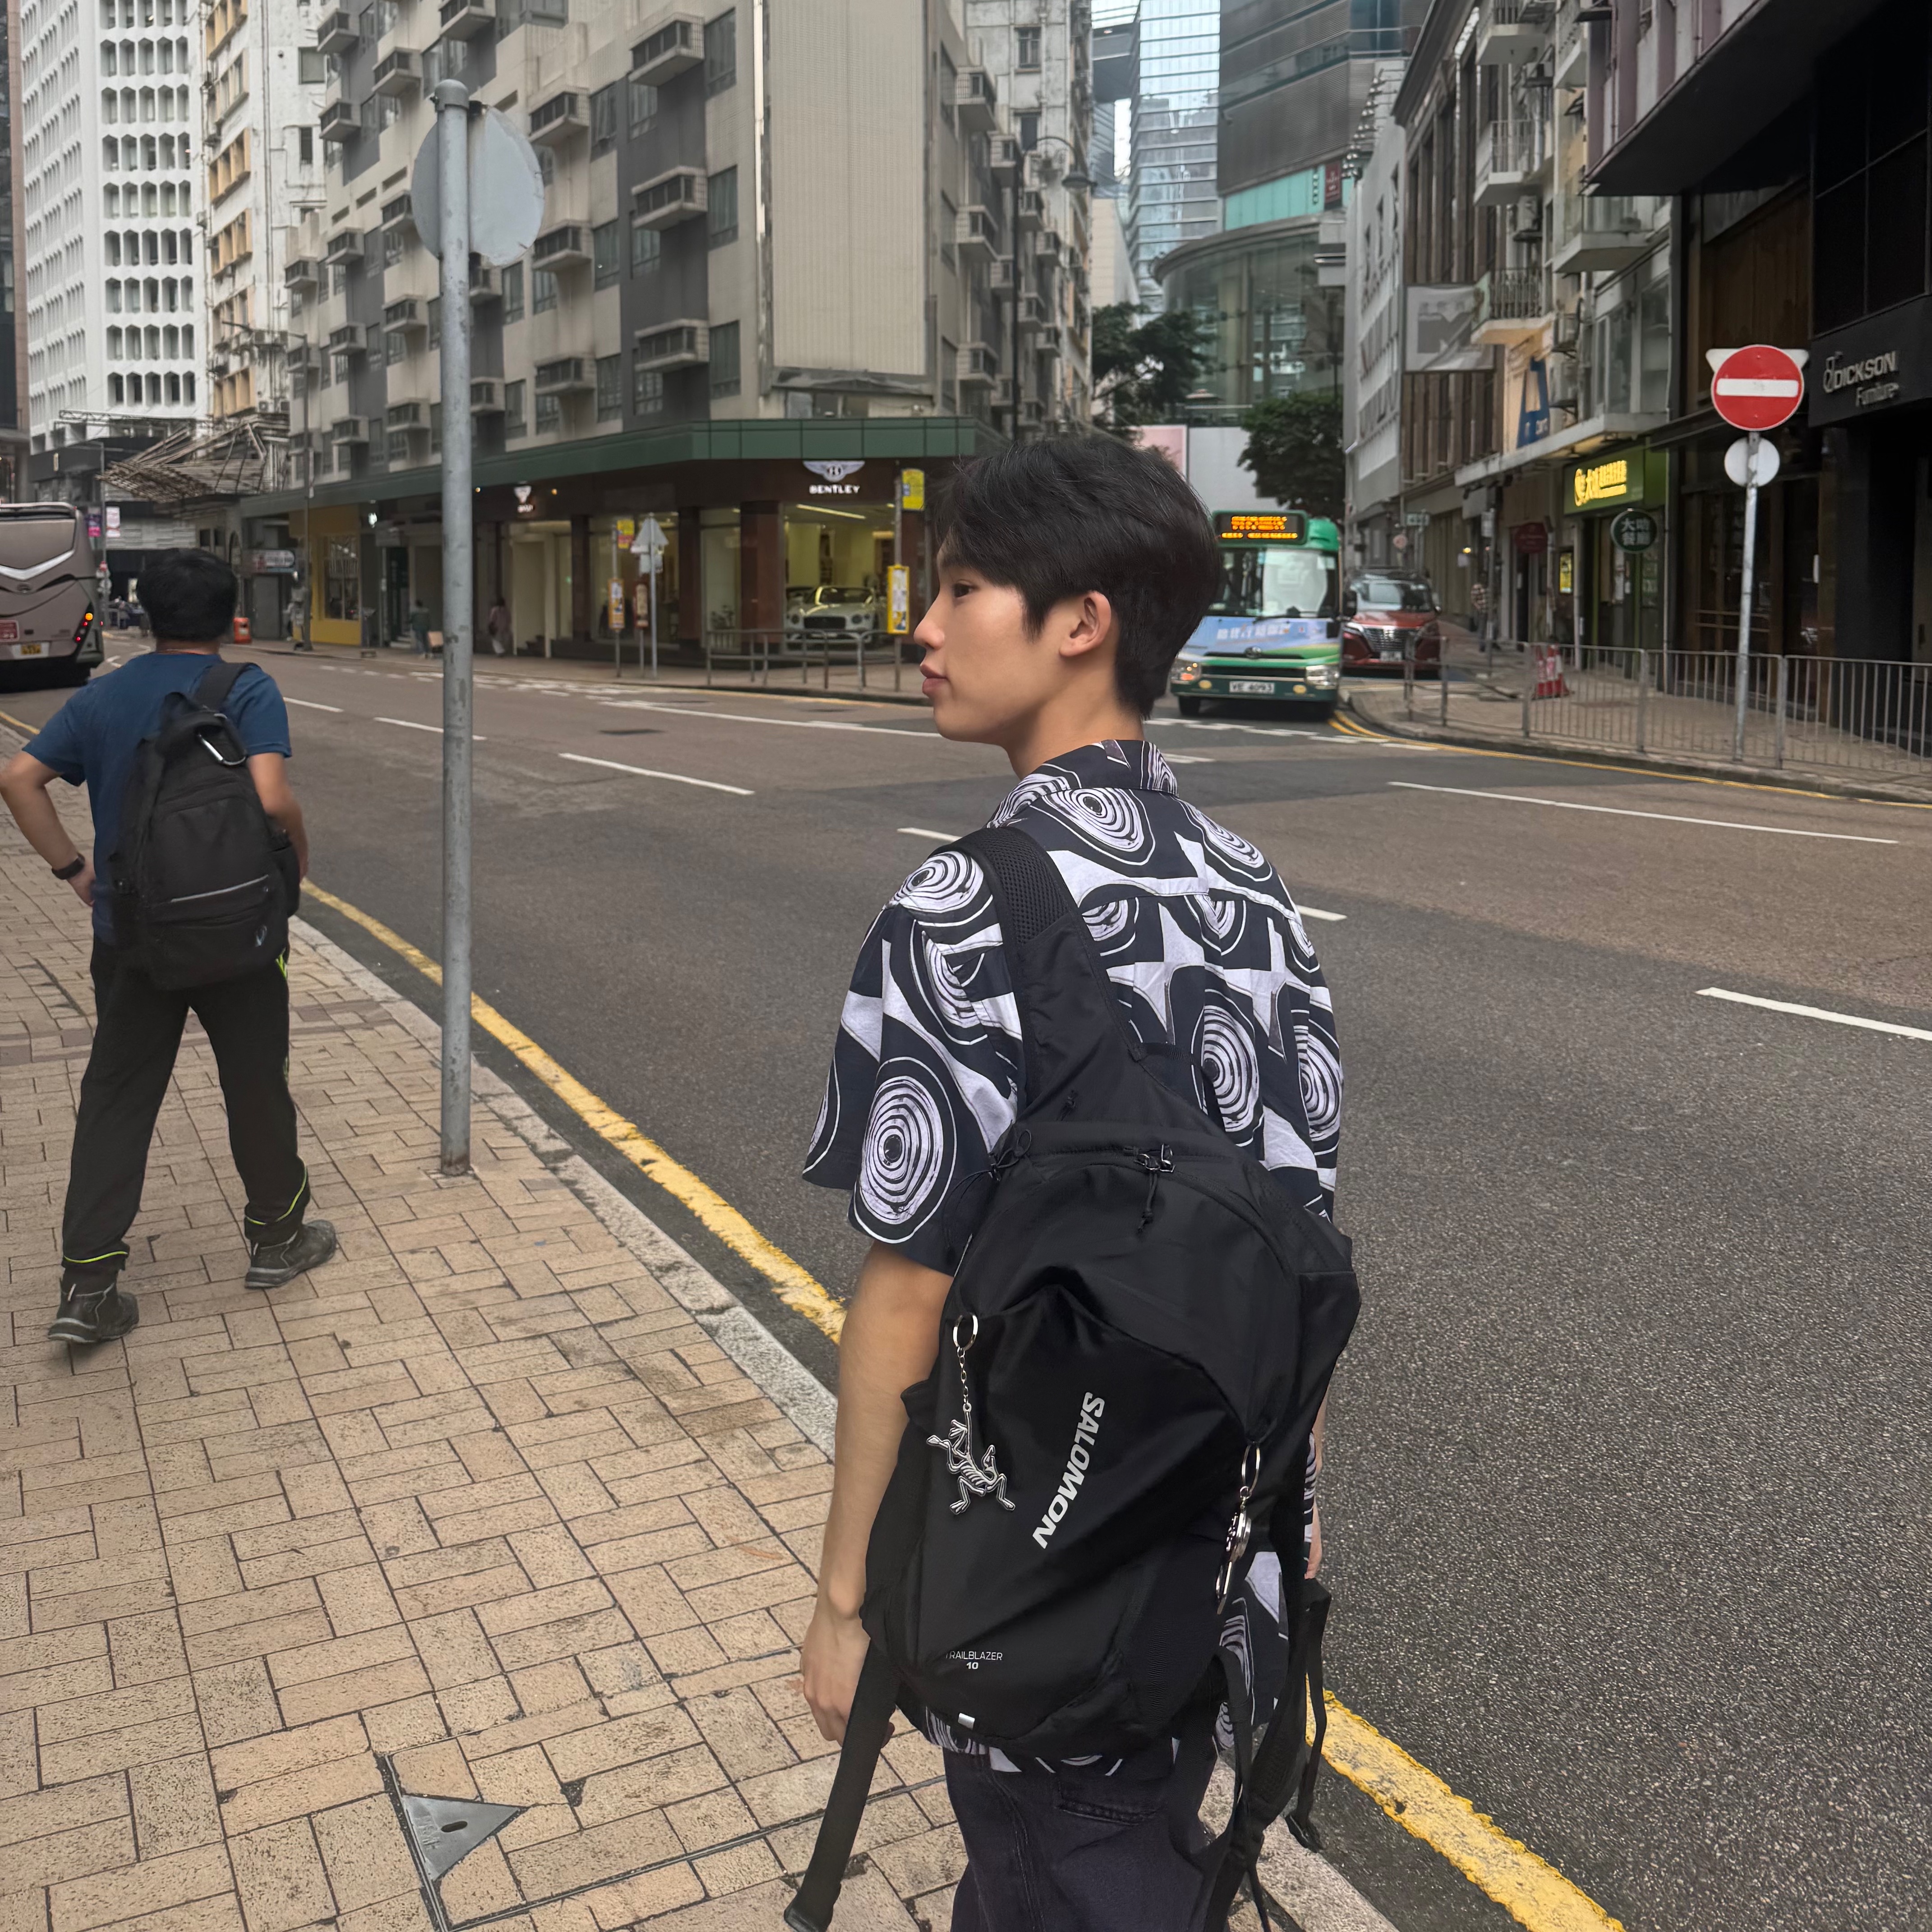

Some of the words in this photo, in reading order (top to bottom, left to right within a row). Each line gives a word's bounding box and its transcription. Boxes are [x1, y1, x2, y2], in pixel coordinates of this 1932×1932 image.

[1834, 350, 1897, 389] DICKSON
[809, 484, 860, 494] BENTLEY
[1033, 1392, 1105, 1549] SALOMON
[946, 1651, 1003, 1661] RAILBLAZER
